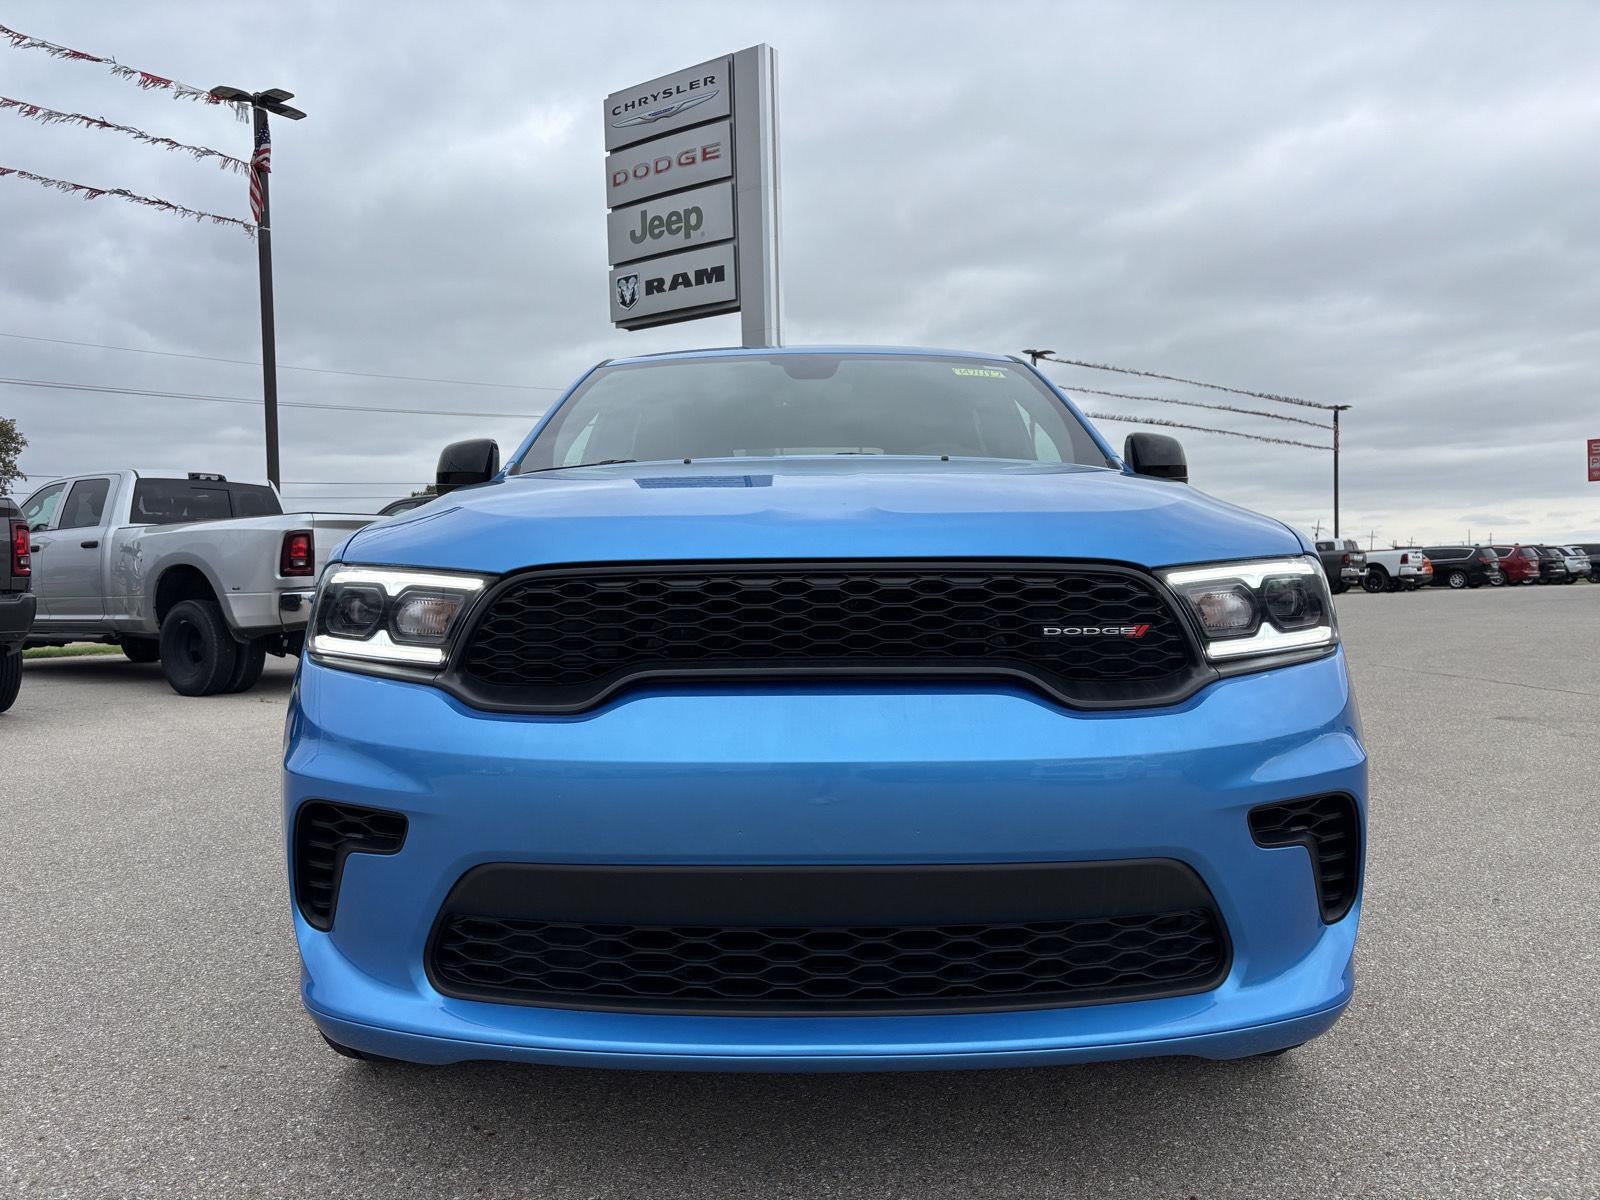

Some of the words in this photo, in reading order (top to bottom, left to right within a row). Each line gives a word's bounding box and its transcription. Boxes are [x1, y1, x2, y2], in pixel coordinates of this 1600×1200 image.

[611, 75, 716, 116] CHRYSLER
[612, 142, 721, 187] DODGE
[629, 205, 704, 244] Jeep
[645, 265, 725, 296] RAM
[1043, 627, 1137, 635] DODGE
